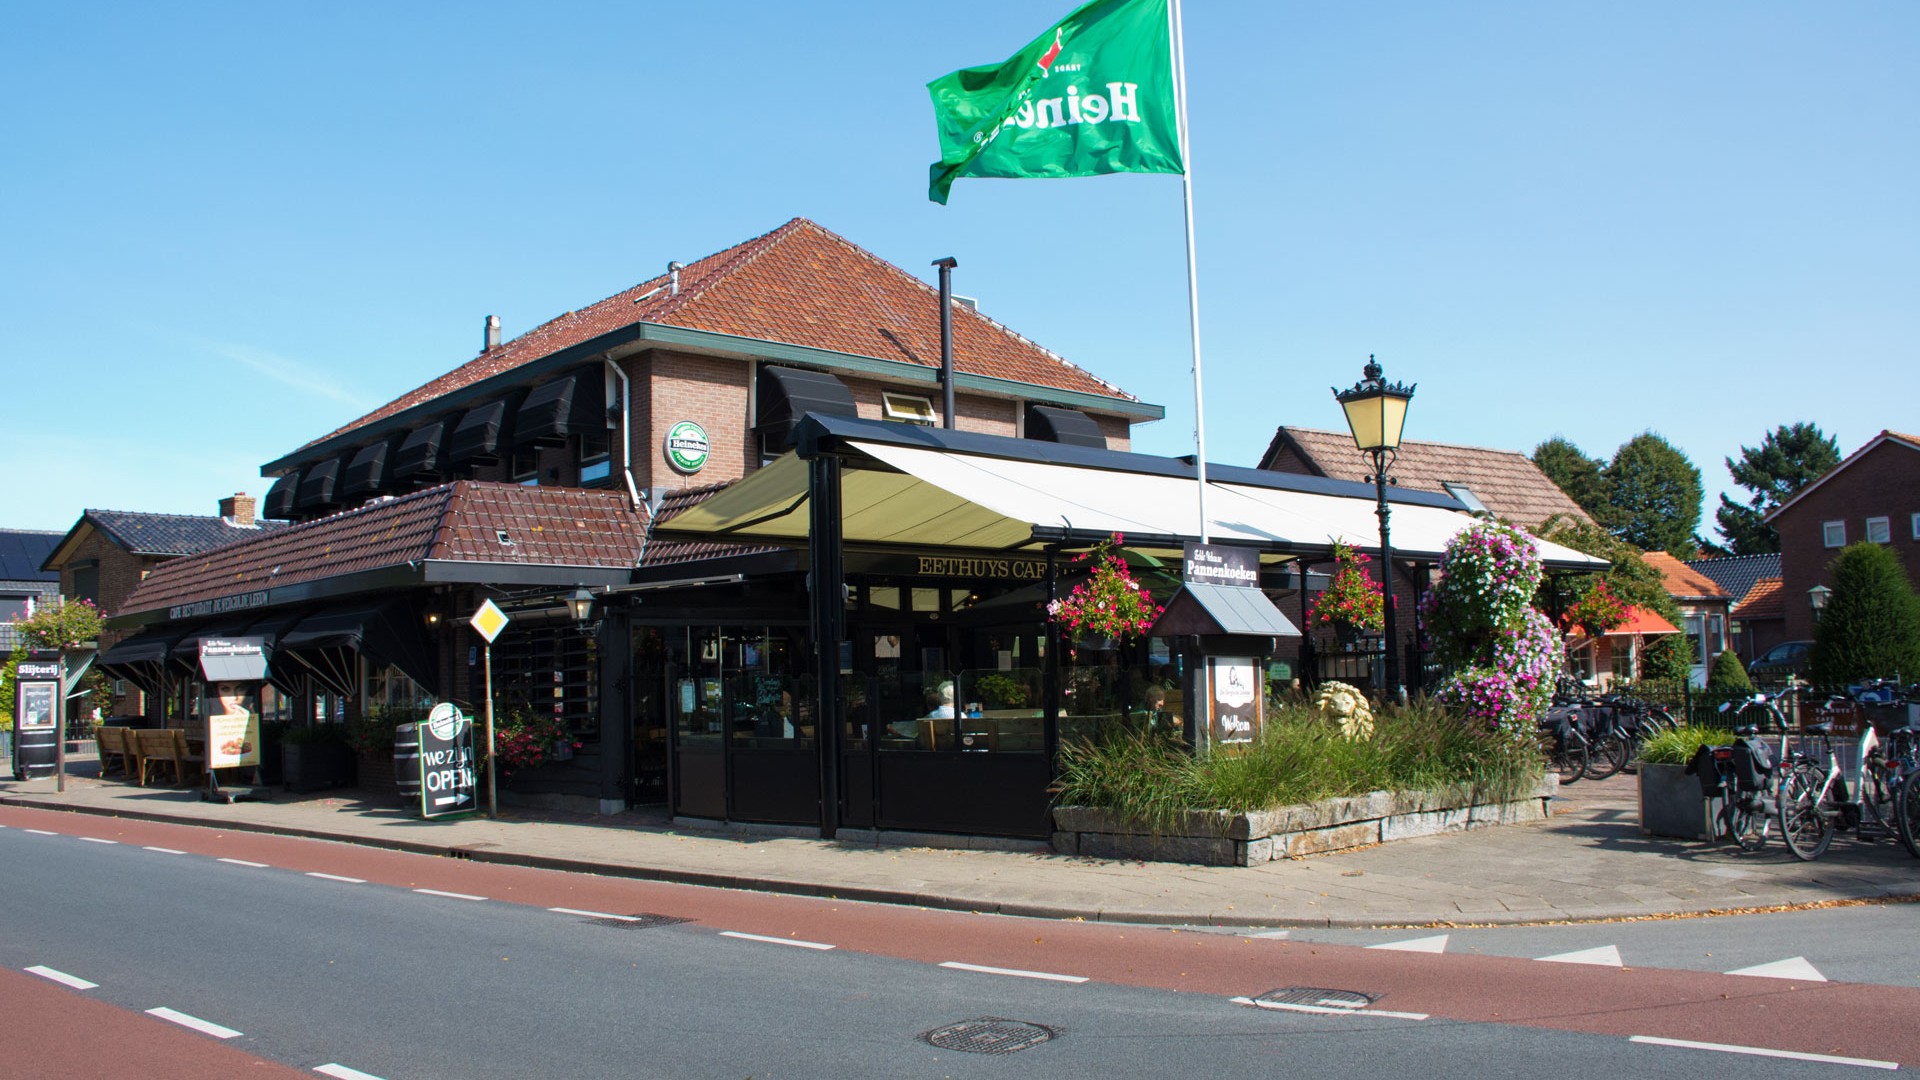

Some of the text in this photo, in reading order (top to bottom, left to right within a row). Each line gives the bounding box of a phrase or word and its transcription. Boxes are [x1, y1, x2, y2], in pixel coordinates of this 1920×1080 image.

[673, 440, 707, 452] Heineken
[918, 556, 1009, 578] EETHUYS
[1188, 560, 1257, 580] Pannenkoeken
[202, 644, 262, 653] Pannenkoeken
[19, 664, 58, 676] Slijterij
[1221, 714, 1250, 731] Welkom
[427, 768, 472, 792] OPEN
